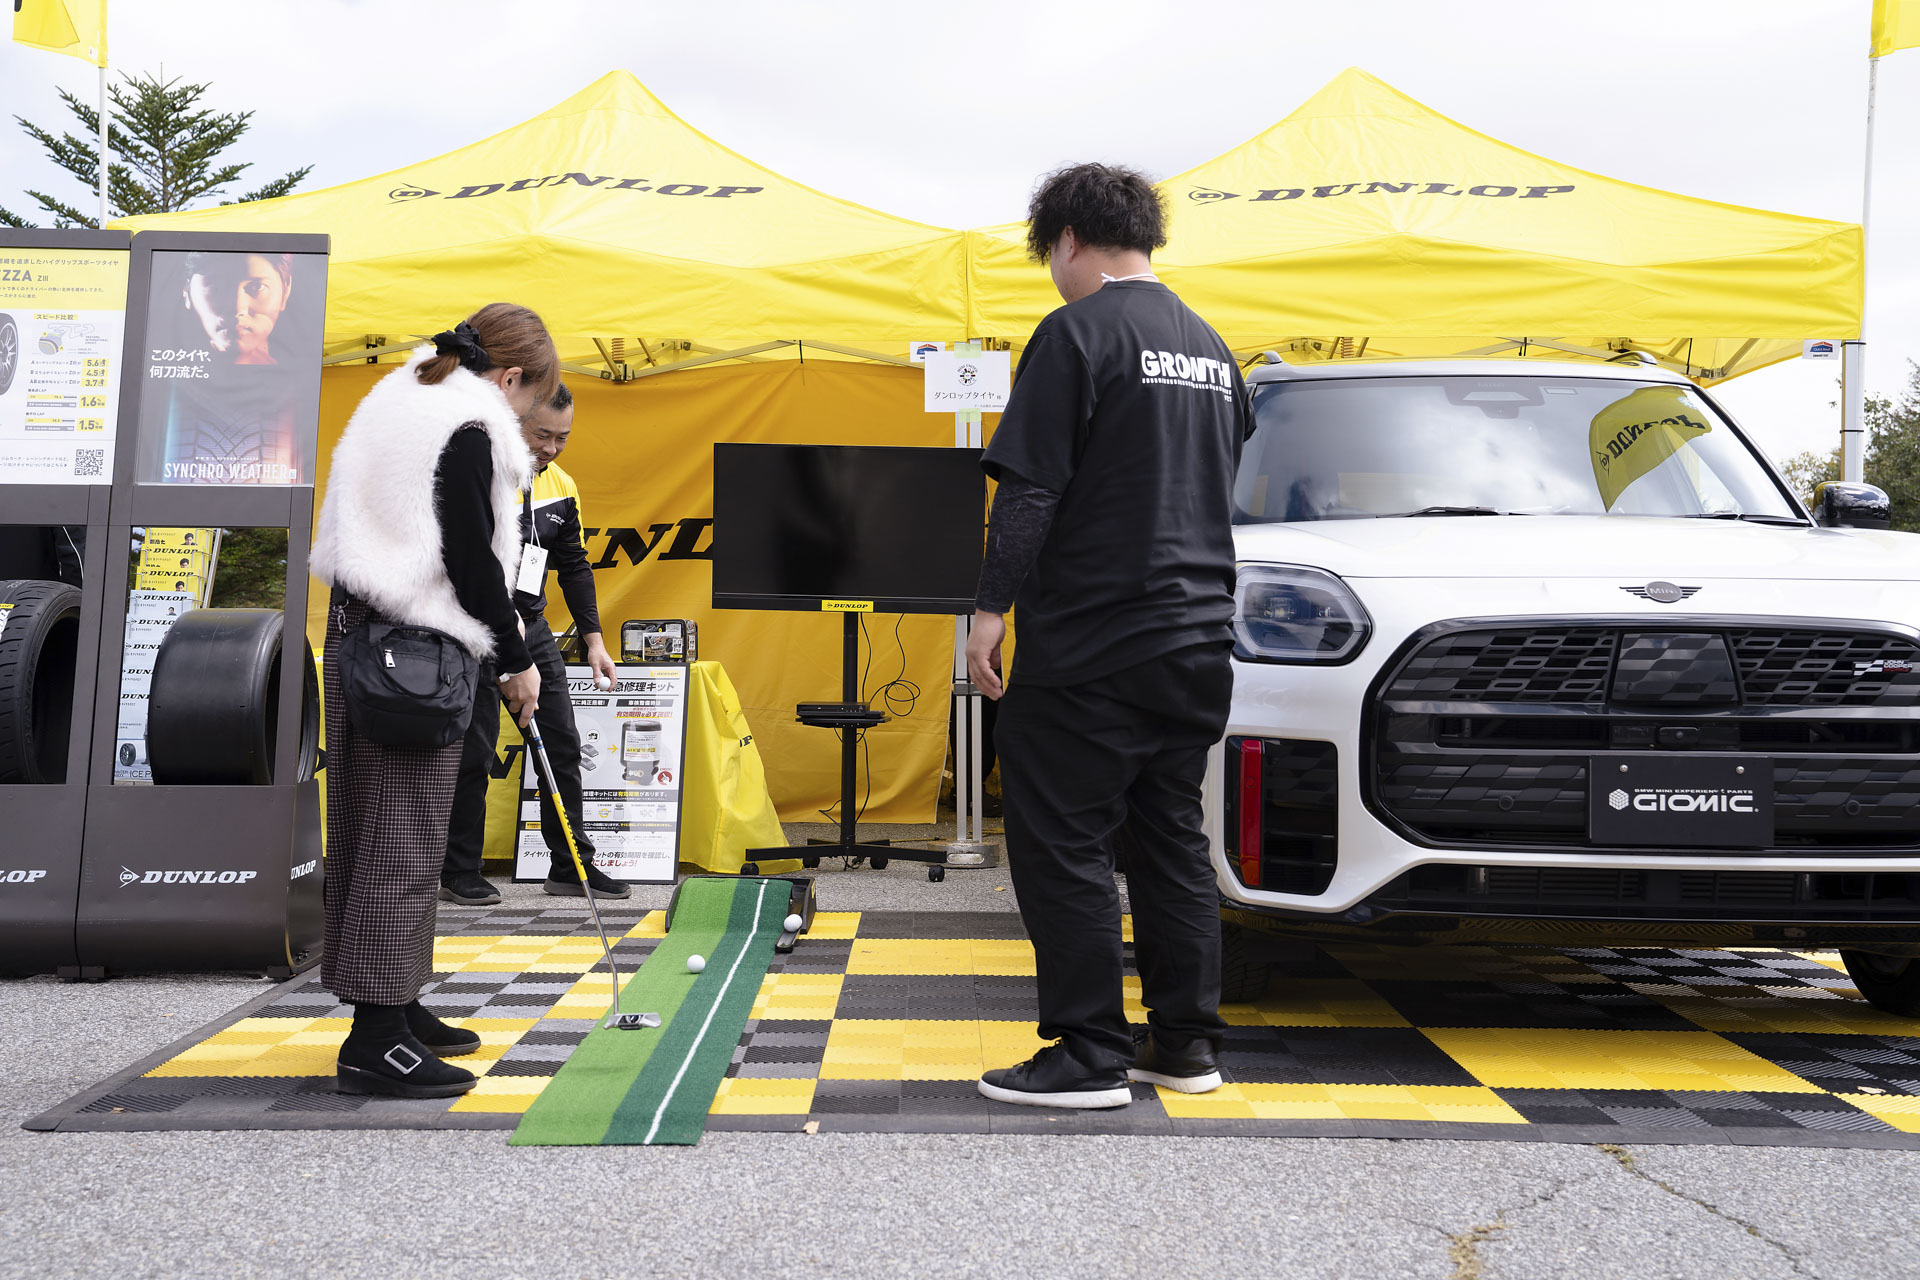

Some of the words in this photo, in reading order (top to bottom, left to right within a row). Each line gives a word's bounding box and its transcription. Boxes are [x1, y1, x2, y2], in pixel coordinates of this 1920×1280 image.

[444, 172, 764, 199] DUNLOP
[1248, 182, 1575, 201] DUNLOP
[0, 270, 32, 281] ZZA
[151, 349, 211, 362] このタイヤ、
[150, 365, 210, 379] 何刀流だ。
[85, 379, 98, 387] 3.7
[81, 396, 97, 407] 1.6
[934, 391, 995, 400] ダンロップタイヤ
[79, 419, 95, 430] 1.5
[164, 463, 224, 478] SYNCHRO
[229, 463, 289, 478] WEATHER
[583, 518, 713, 570] NL
[1633, 794, 1753, 812] GIOMIC
[593, 851, 671, 859] ットの有効期限を確認し、
[140, 870, 257, 883] DUNLOP
